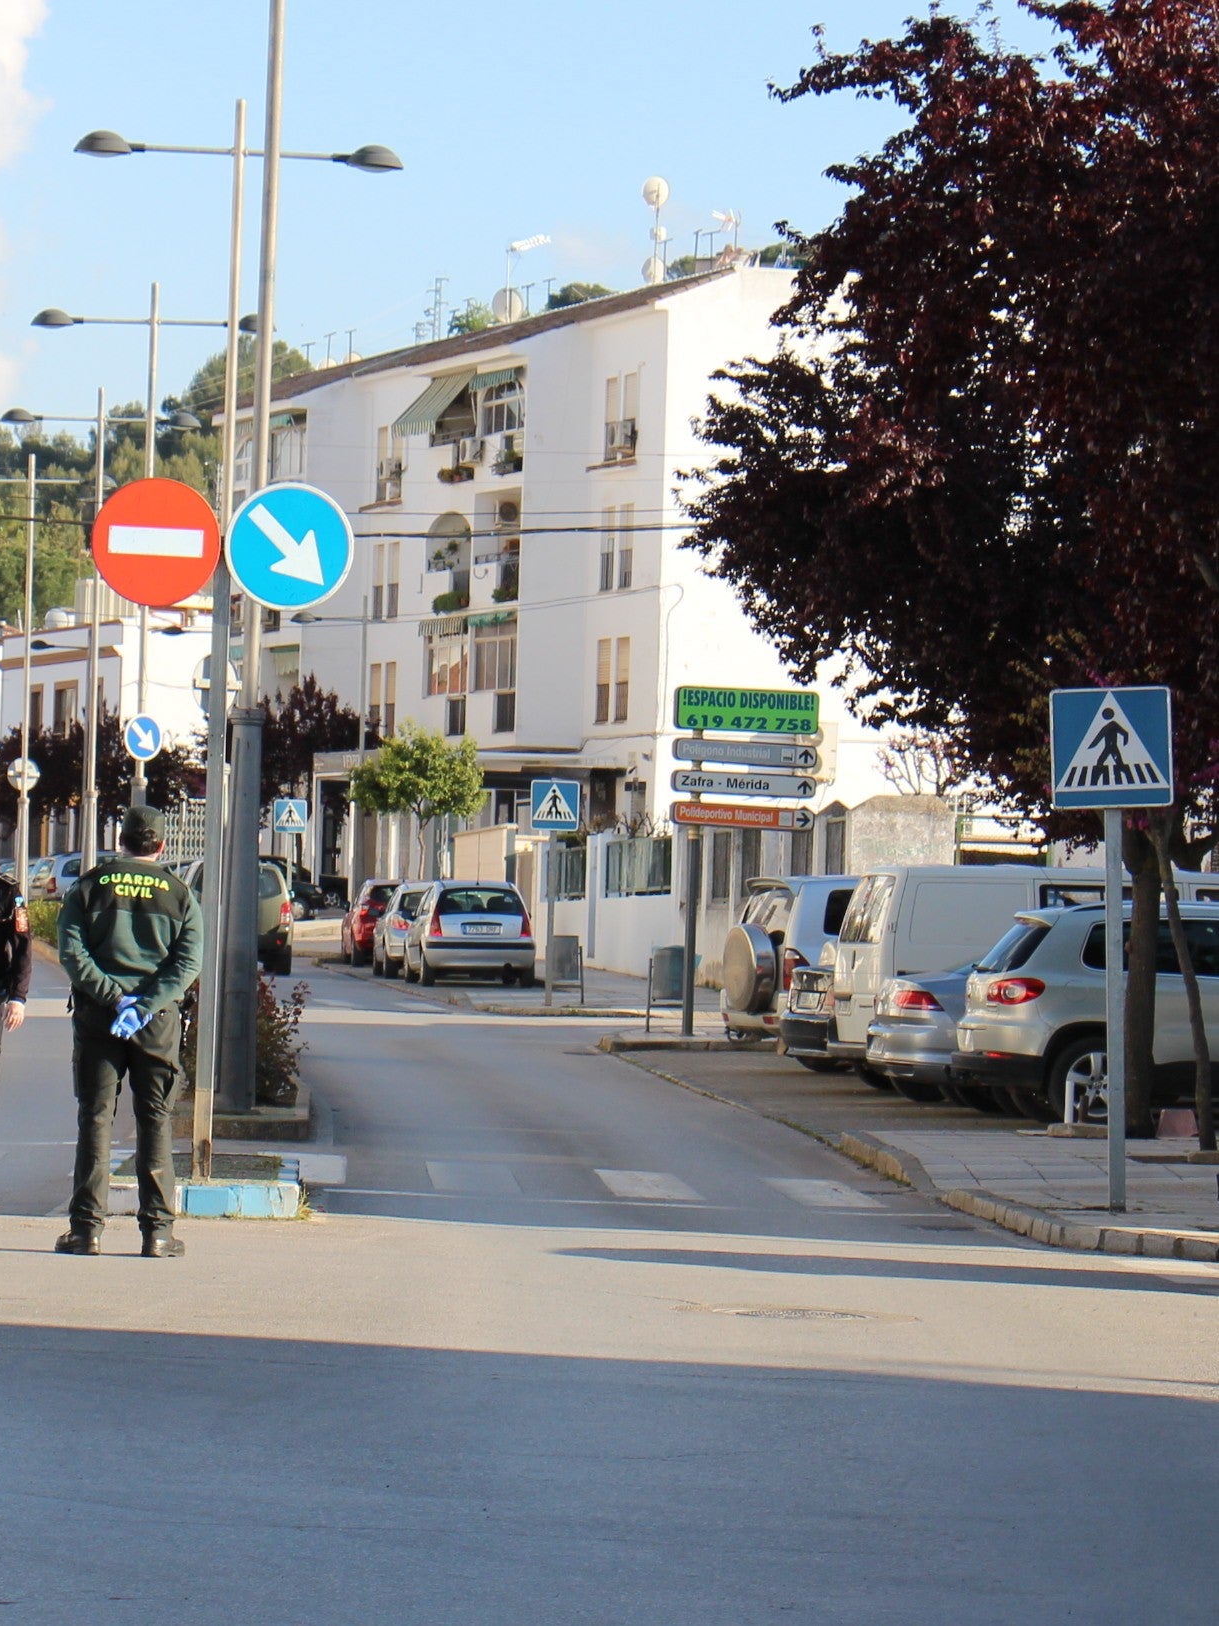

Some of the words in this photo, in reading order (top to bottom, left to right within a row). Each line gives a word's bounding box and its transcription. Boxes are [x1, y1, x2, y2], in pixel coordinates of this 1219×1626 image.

[740, 692, 814, 711] DISPONIBLE!
[686, 714, 724, 728] 619
[730, 716, 768, 730] 472
[775, 718, 812, 731] 758
[727, 745, 771, 759] Industrial
[681, 775, 714, 787] Zafra
[726, 777, 770, 790] Mérida
[680, 806, 732, 820] Polideportivo
[734, 810, 774, 823] Municipal
[99, 873, 170, 892] GUARDIA
[114, 884, 153, 899] CIVIL
